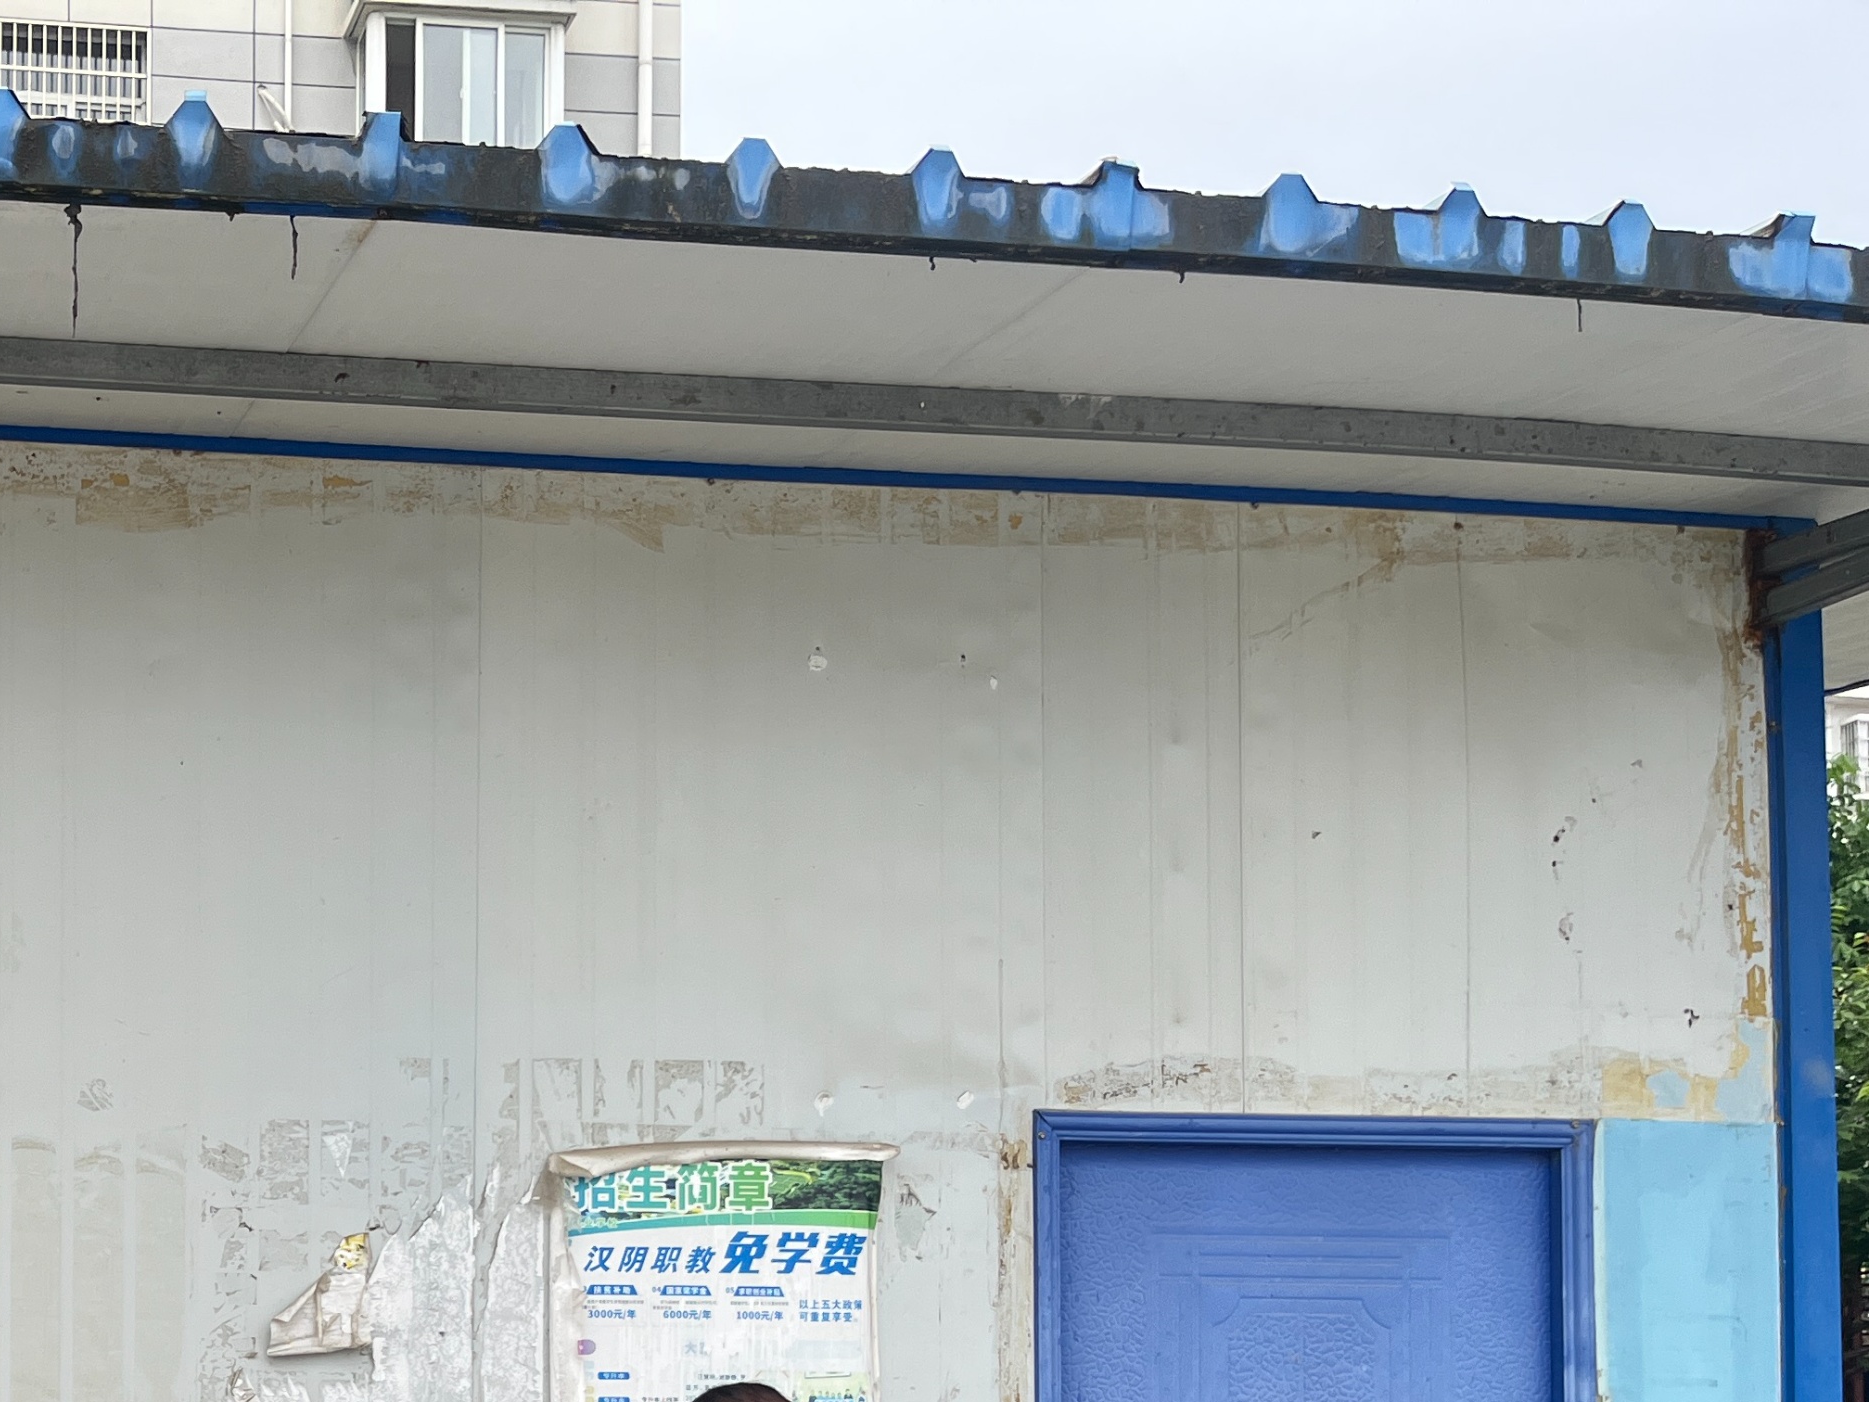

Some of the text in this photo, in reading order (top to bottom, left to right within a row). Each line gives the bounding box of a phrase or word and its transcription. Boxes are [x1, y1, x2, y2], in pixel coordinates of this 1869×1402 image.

[574, 1160, 771, 1212] 招生简章
[583, 1231, 867, 1276] 汉阴职教免学费
